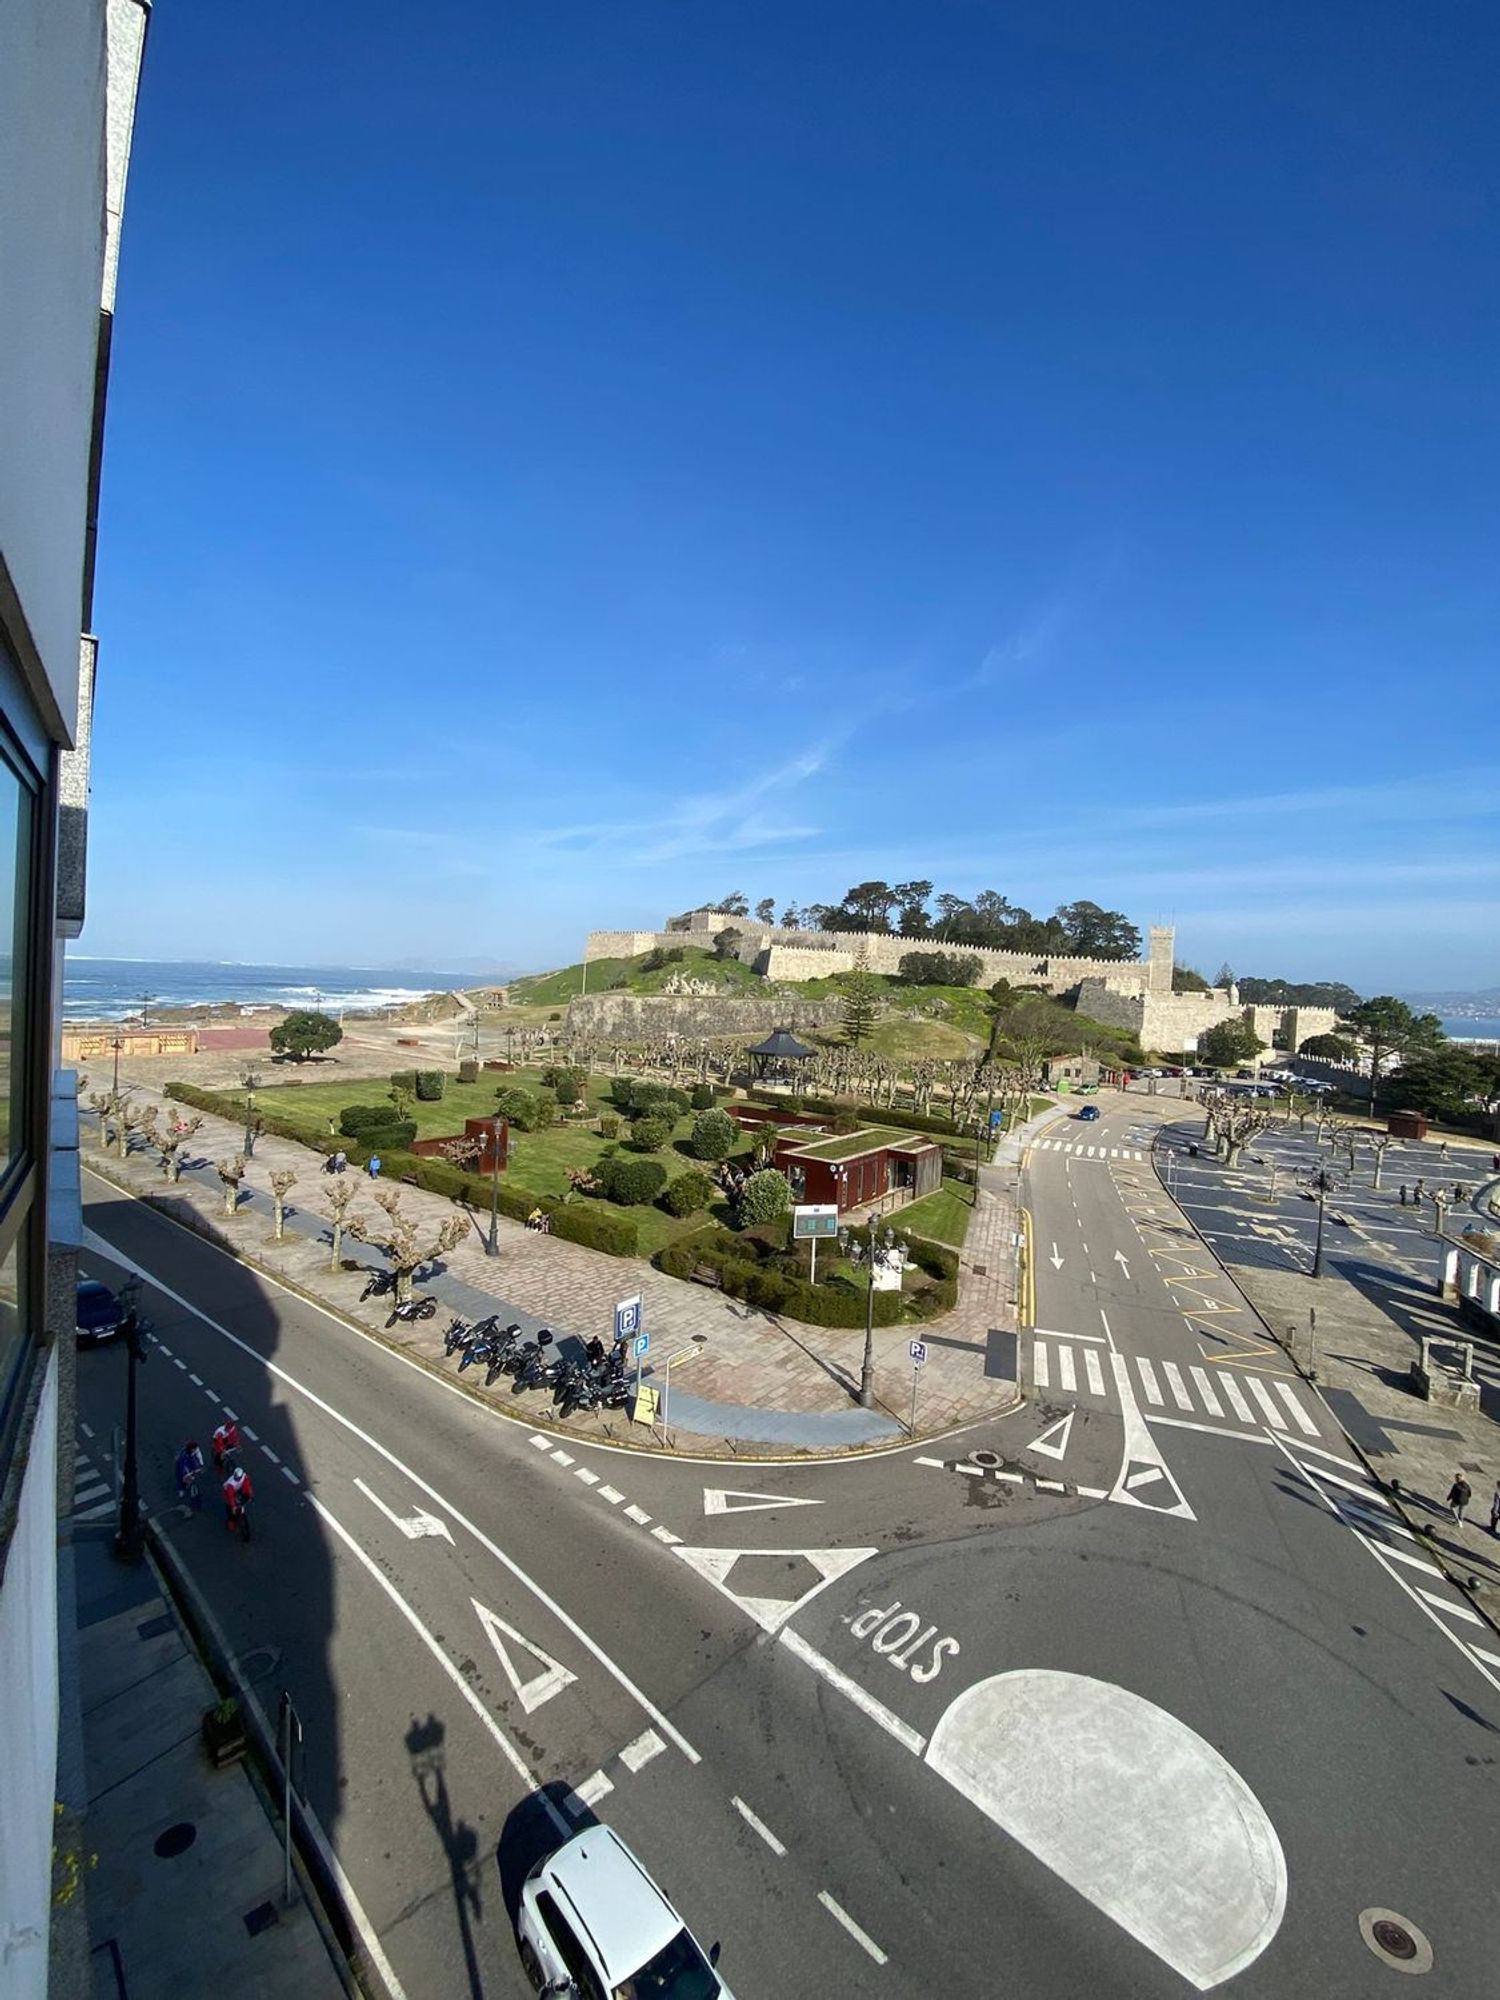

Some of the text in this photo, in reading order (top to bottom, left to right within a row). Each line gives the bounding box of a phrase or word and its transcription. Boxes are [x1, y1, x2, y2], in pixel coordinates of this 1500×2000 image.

[623, 1309, 634, 1328] P
[637, 1338, 647, 1355] P
[850, 1601, 960, 1683] STOP
